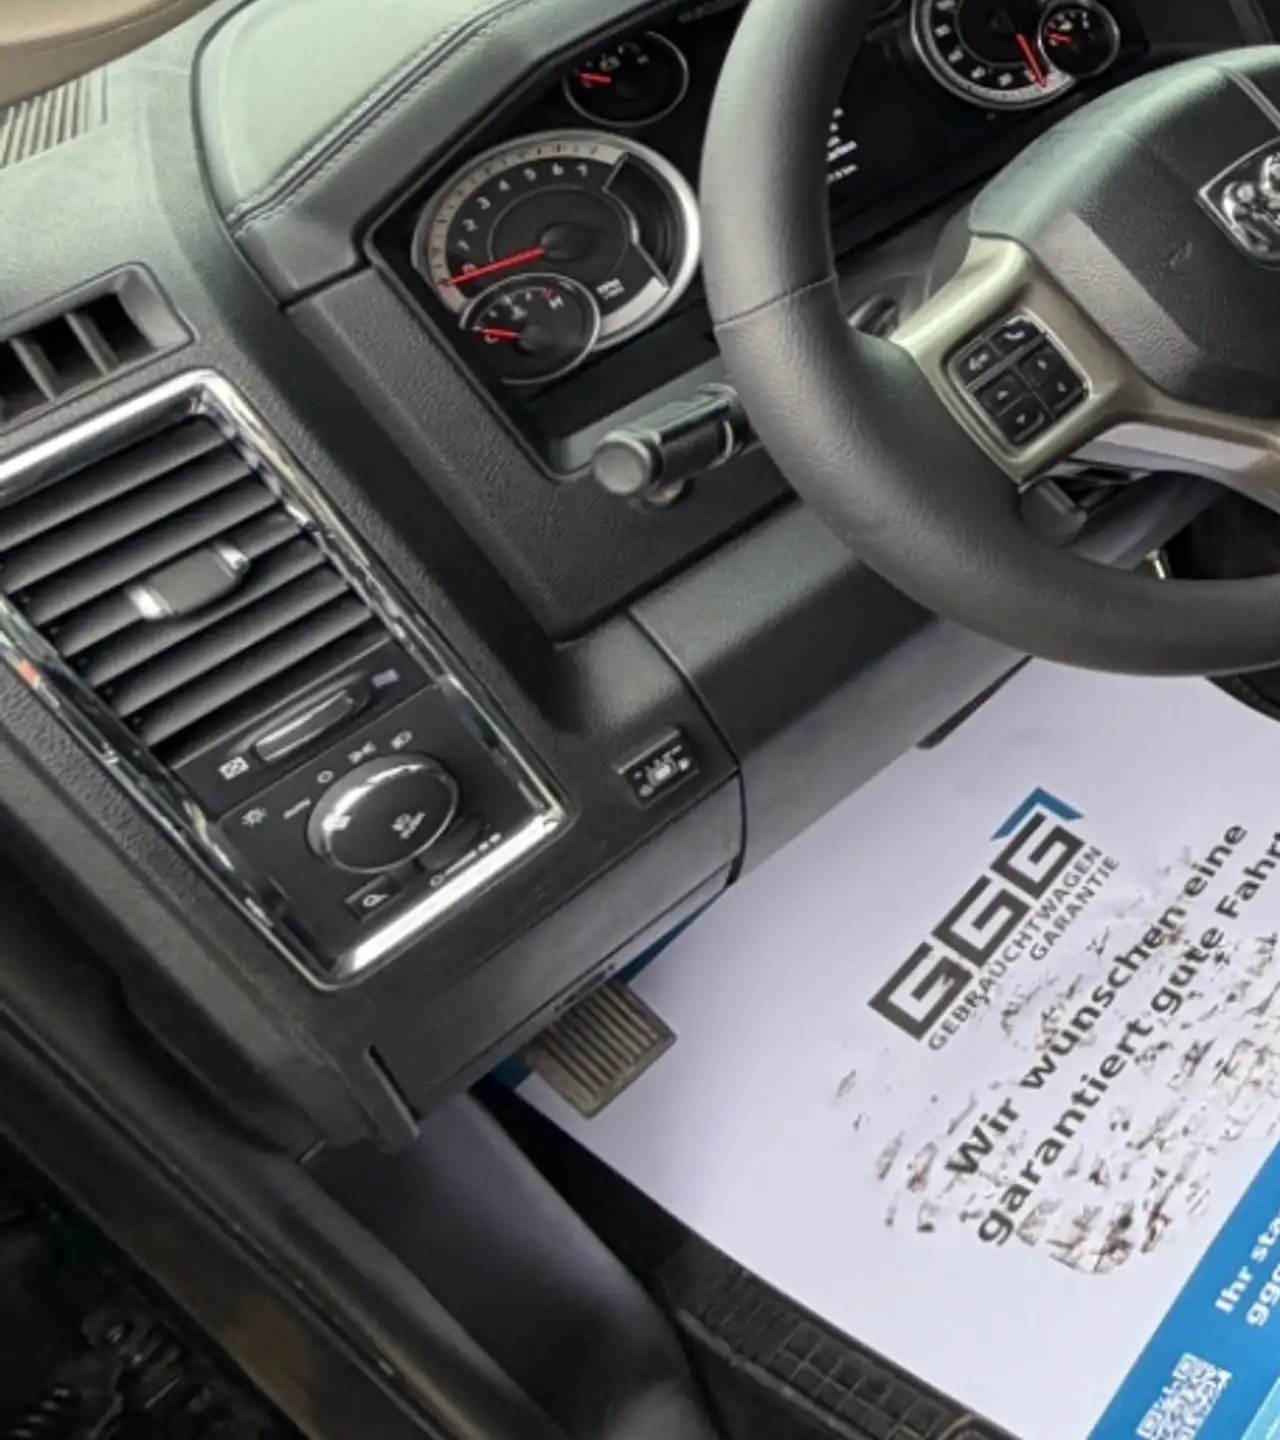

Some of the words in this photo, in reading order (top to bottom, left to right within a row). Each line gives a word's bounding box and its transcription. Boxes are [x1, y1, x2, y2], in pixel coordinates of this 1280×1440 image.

[867, 810, 1087, 1043] GGG
[927, 845, 1104, 1051] GEBRAUCHTWAGEN
[944, 1097, 1020, 1175] Wir
[1183, 823, 1249, 898] eine
[1028, 856, 1121, 962] GARANTIE
[977, 1018, 1154, 1246] garantiert
[1150, 926, 1225, 1016] gute
[1214, 1264, 1254, 1312] Ihr
